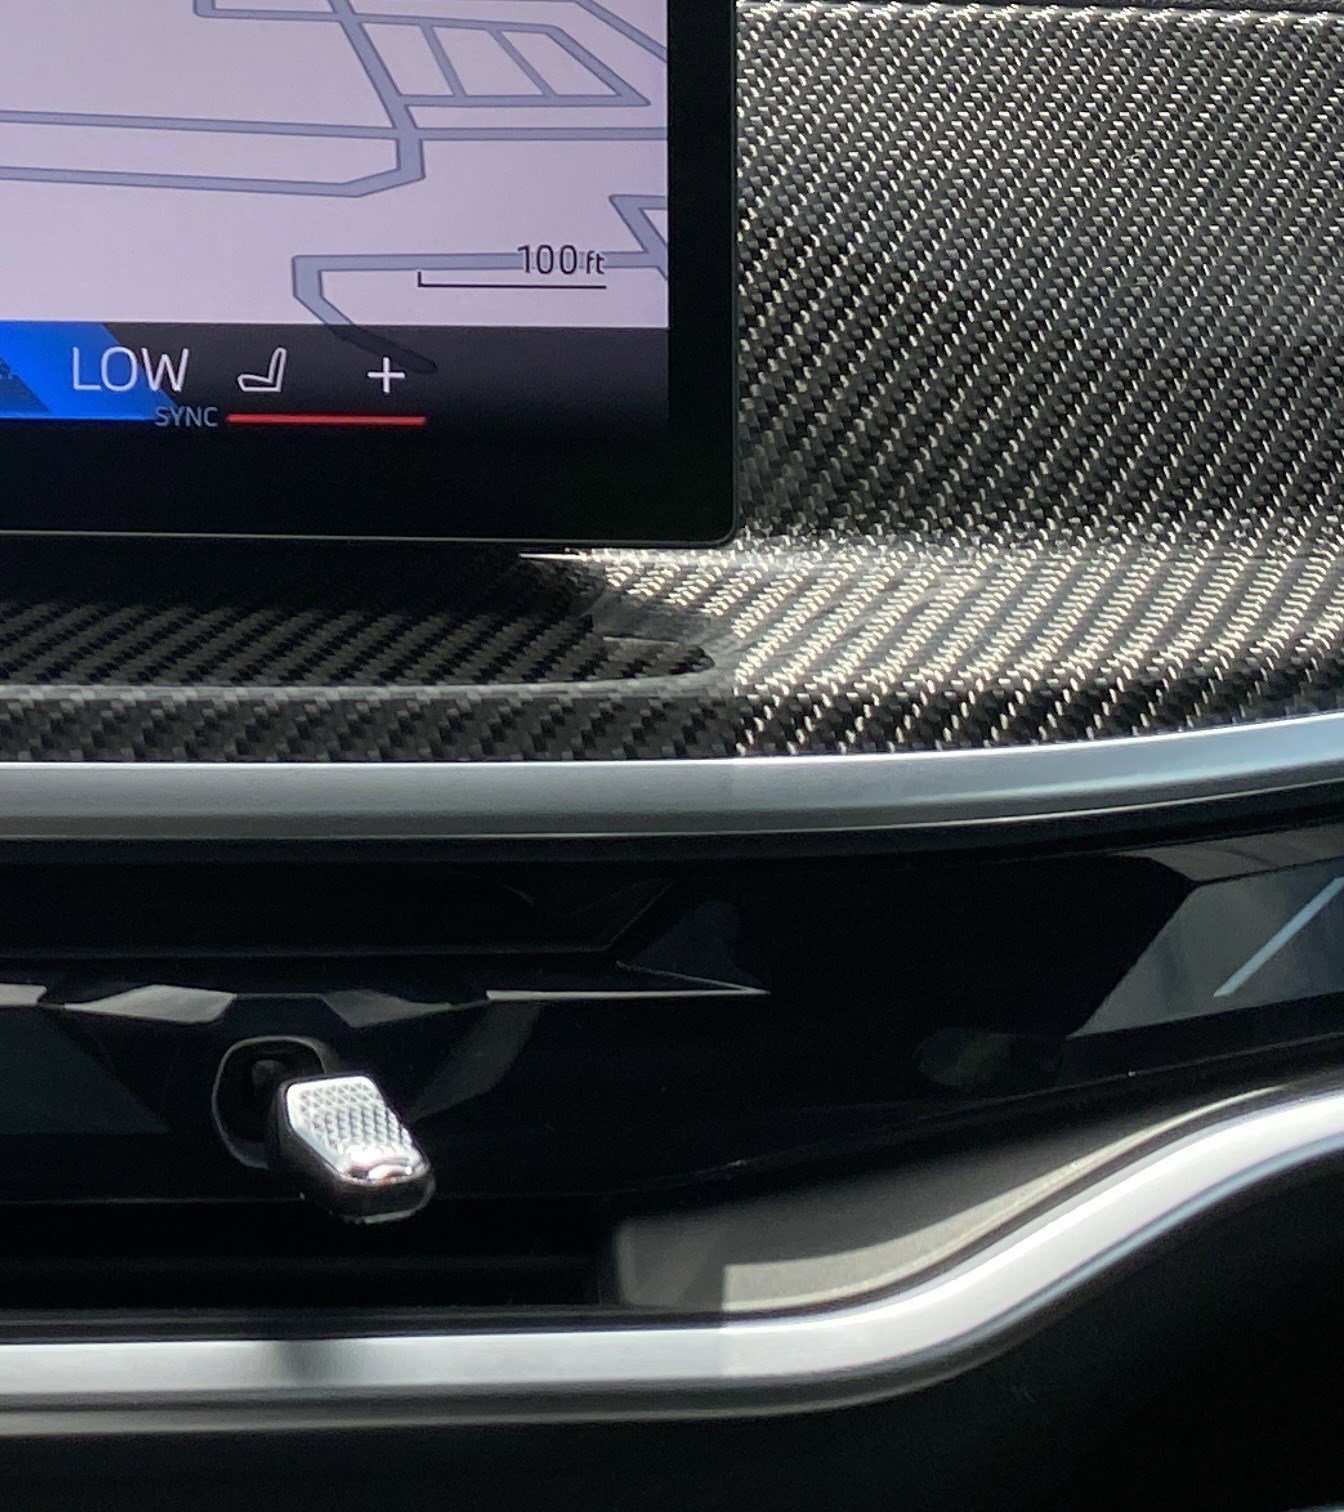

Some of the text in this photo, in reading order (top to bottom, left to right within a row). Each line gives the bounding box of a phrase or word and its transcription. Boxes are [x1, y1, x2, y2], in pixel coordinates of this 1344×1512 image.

[517, 244, 578, 276] 100
[71, 346, 190, 392] LOW
[153, 405, 219, 428] SYNC
